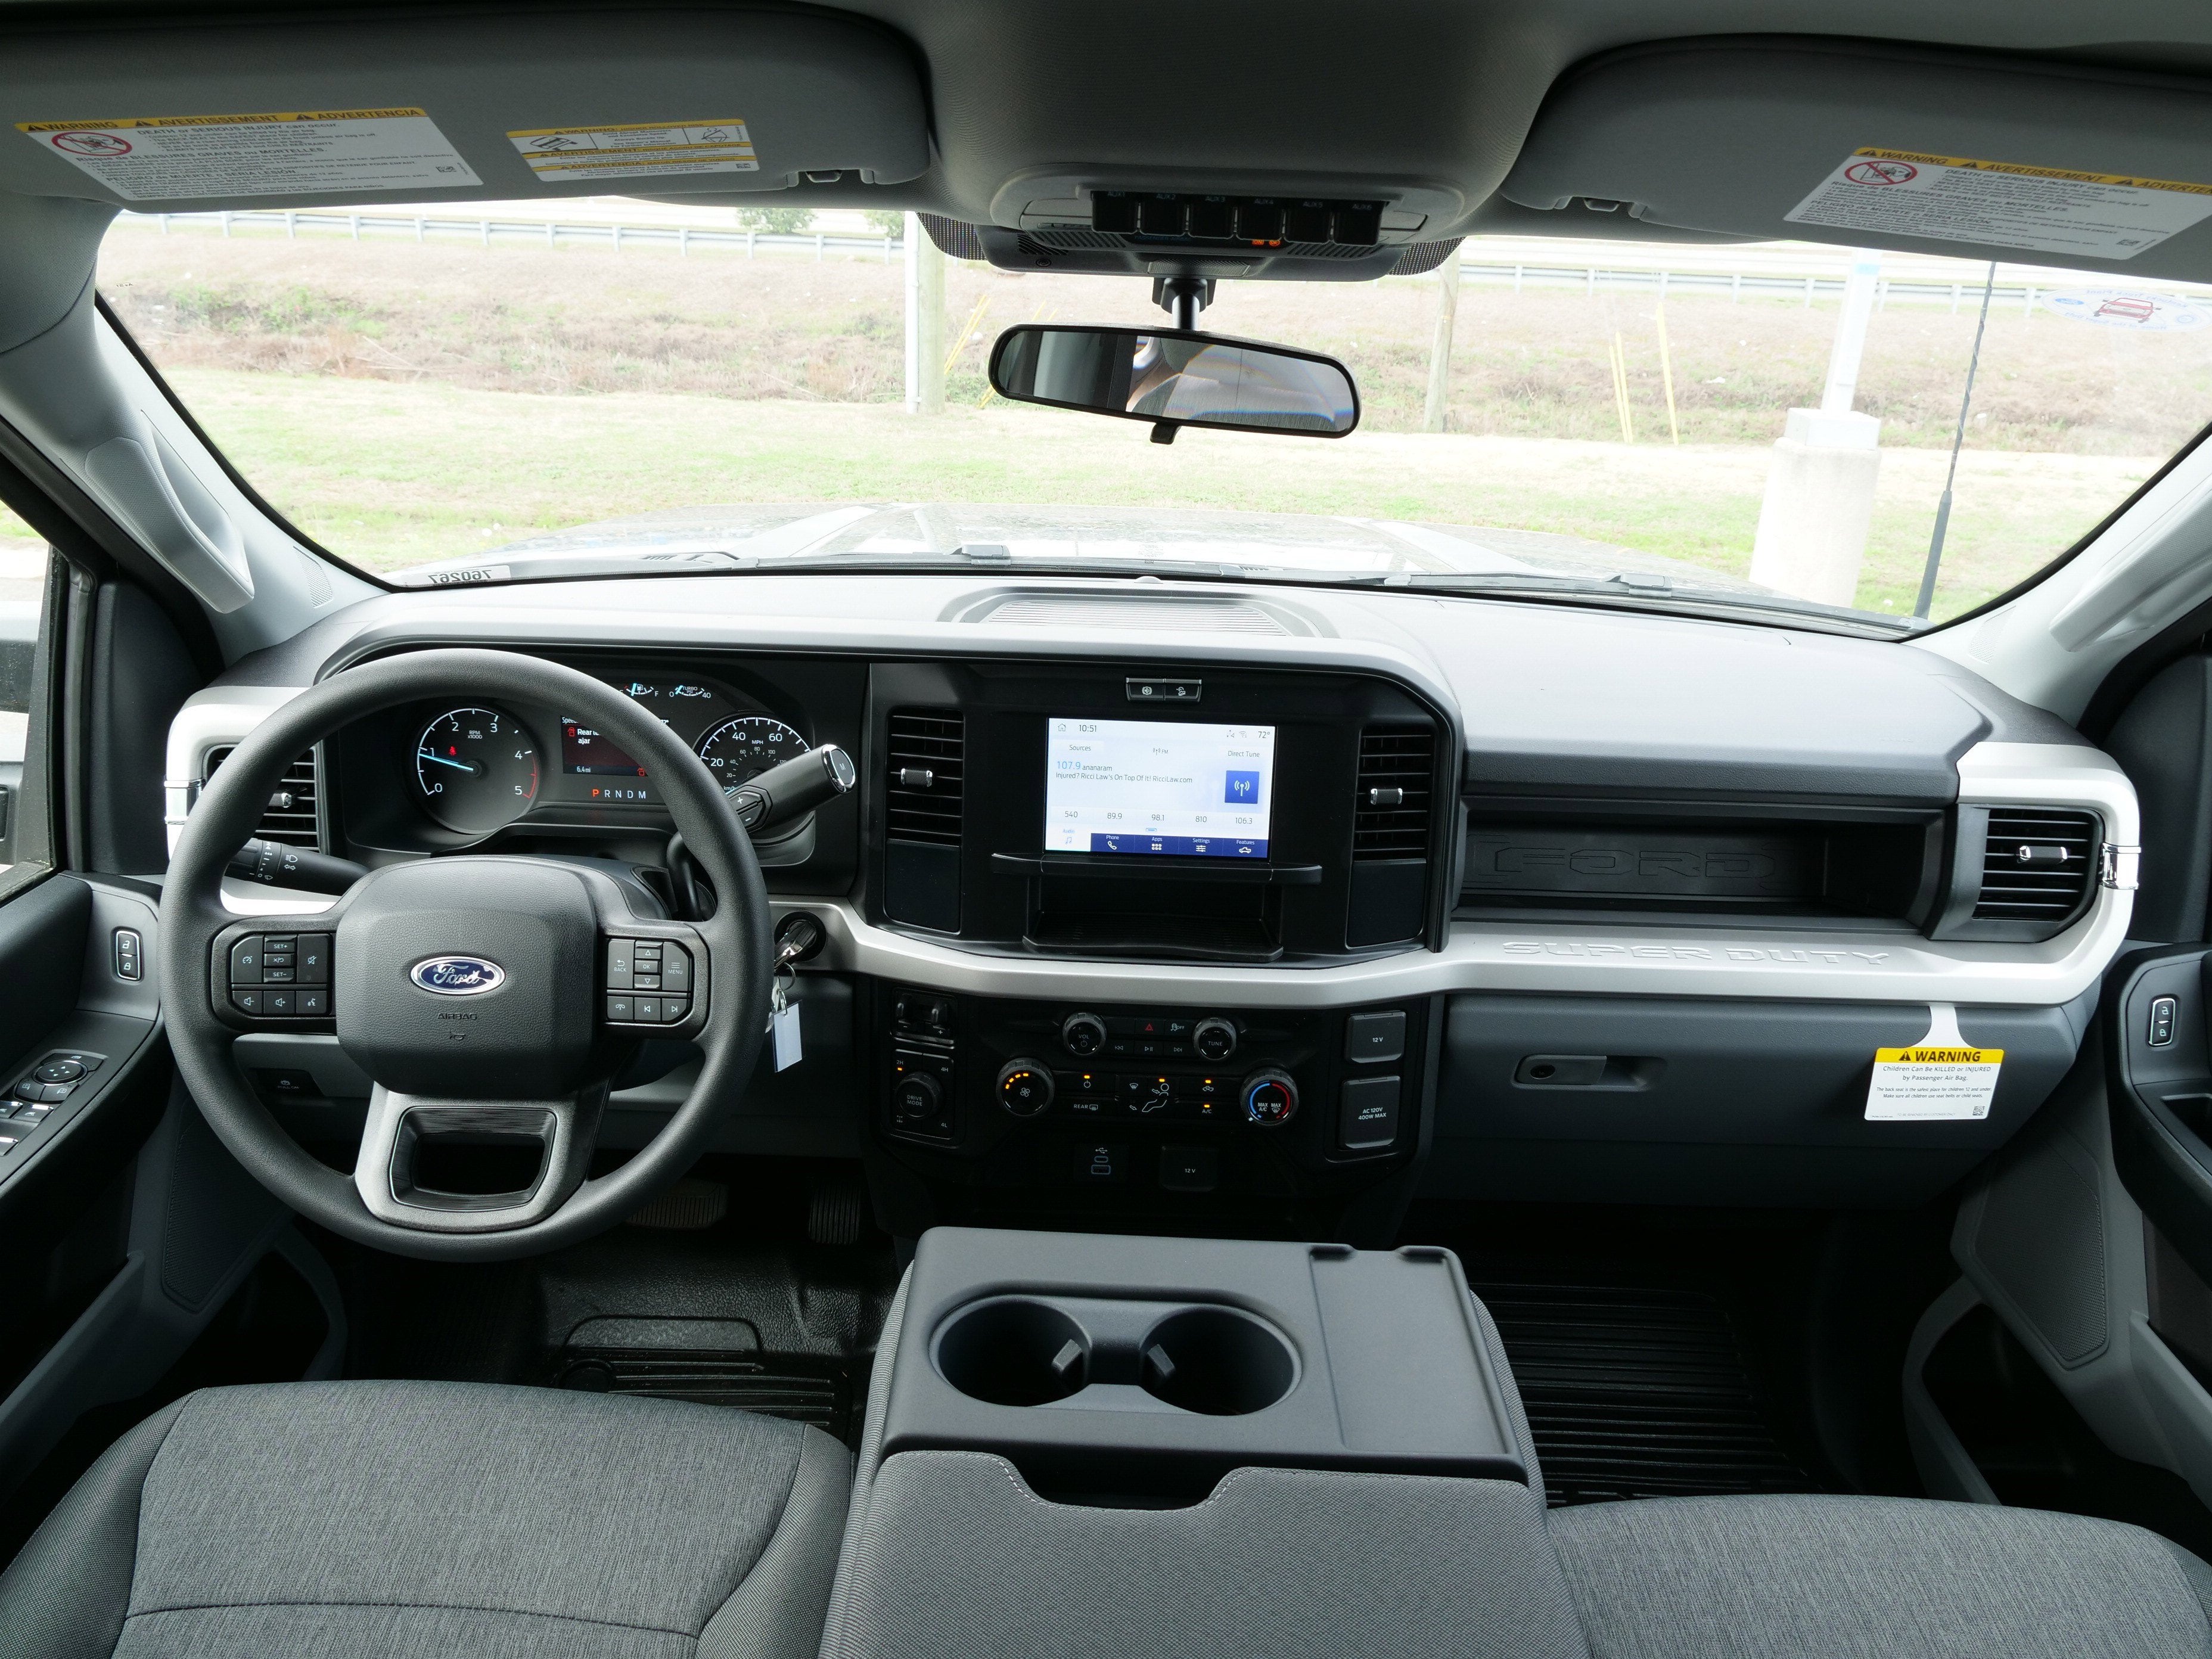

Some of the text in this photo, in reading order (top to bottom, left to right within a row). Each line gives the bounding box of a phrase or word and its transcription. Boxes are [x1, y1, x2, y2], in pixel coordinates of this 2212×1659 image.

[318, 109, 420, 119] ADVERTENCIA
[158, 114, 279, 126] AVERTISSEMENT
[42, 121, 118, 131] WARNING
[1881, 151, 1949, 164] WARNING
[1983, 163, 2108, 181] AVERTISSEMENT
[451, 722, 459, 731] 2
[490, 723, 498, 732] 3
[1079, 724, 1097, 732] 10:51
[732, 732, 746, 741] 40
[769, 733, 783, 742] 60
[1257, 731, 1270, 739] 72°
[514, 750, 523, 760] 4
[710, 758, 723, 767] 20
[1057, 760, 1081, 770] 107.9
[1152, 775, 1192, 784] RicciLaw.com
[434, 783, 443, 793] 0
[514, 786, 523, 796] 5
[592, 788, 646, 799] P R N D M
[1495, 846, 1776, 879] FORD
[1503, 941, 1890, 965] SUPER DUTY
[433, 963, 480, 987] Ford
[1915, 1051, 1981, 1062] WARNING
